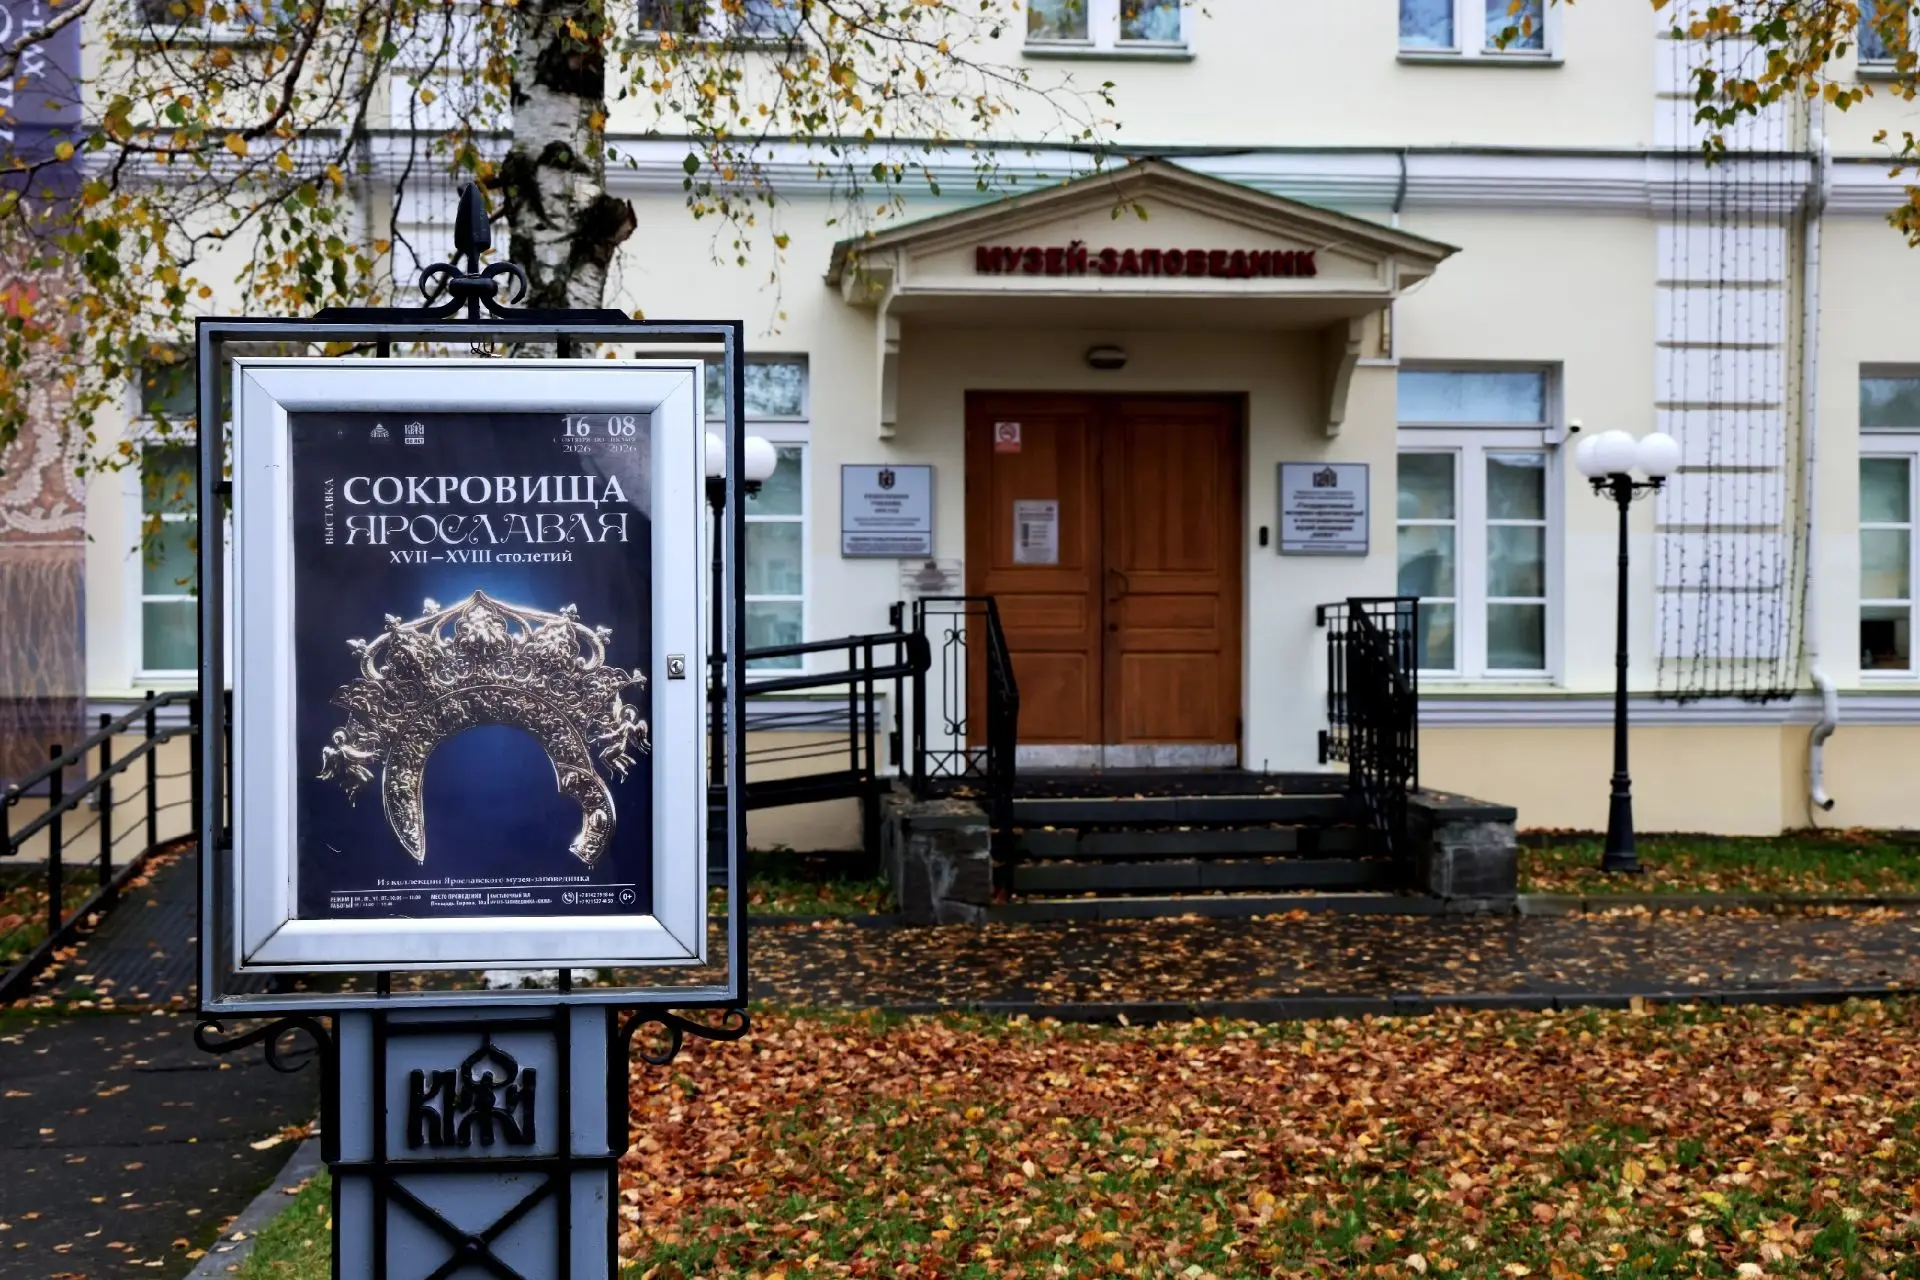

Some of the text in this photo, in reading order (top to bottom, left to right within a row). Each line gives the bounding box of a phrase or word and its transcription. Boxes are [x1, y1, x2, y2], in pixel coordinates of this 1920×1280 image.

[975, 240, 1318, 278] МУЗЕЙ-ЗАПОВЕДНИК
[561, 415, 636, 437] 16 08
[562, 444, 592, 453] 2026
[343, 475, 629, 509] СОКРОВИЩА
[324, 477, 335, 545] ВЫСТАВКА
[344, 512, 629, 545] ЯРОСЛАВЛЯ
[496, 549, 573, 563] столетий
[622, 893, 633, 901] 0+
[408, 1046, 537, 1149] КИЖИ
